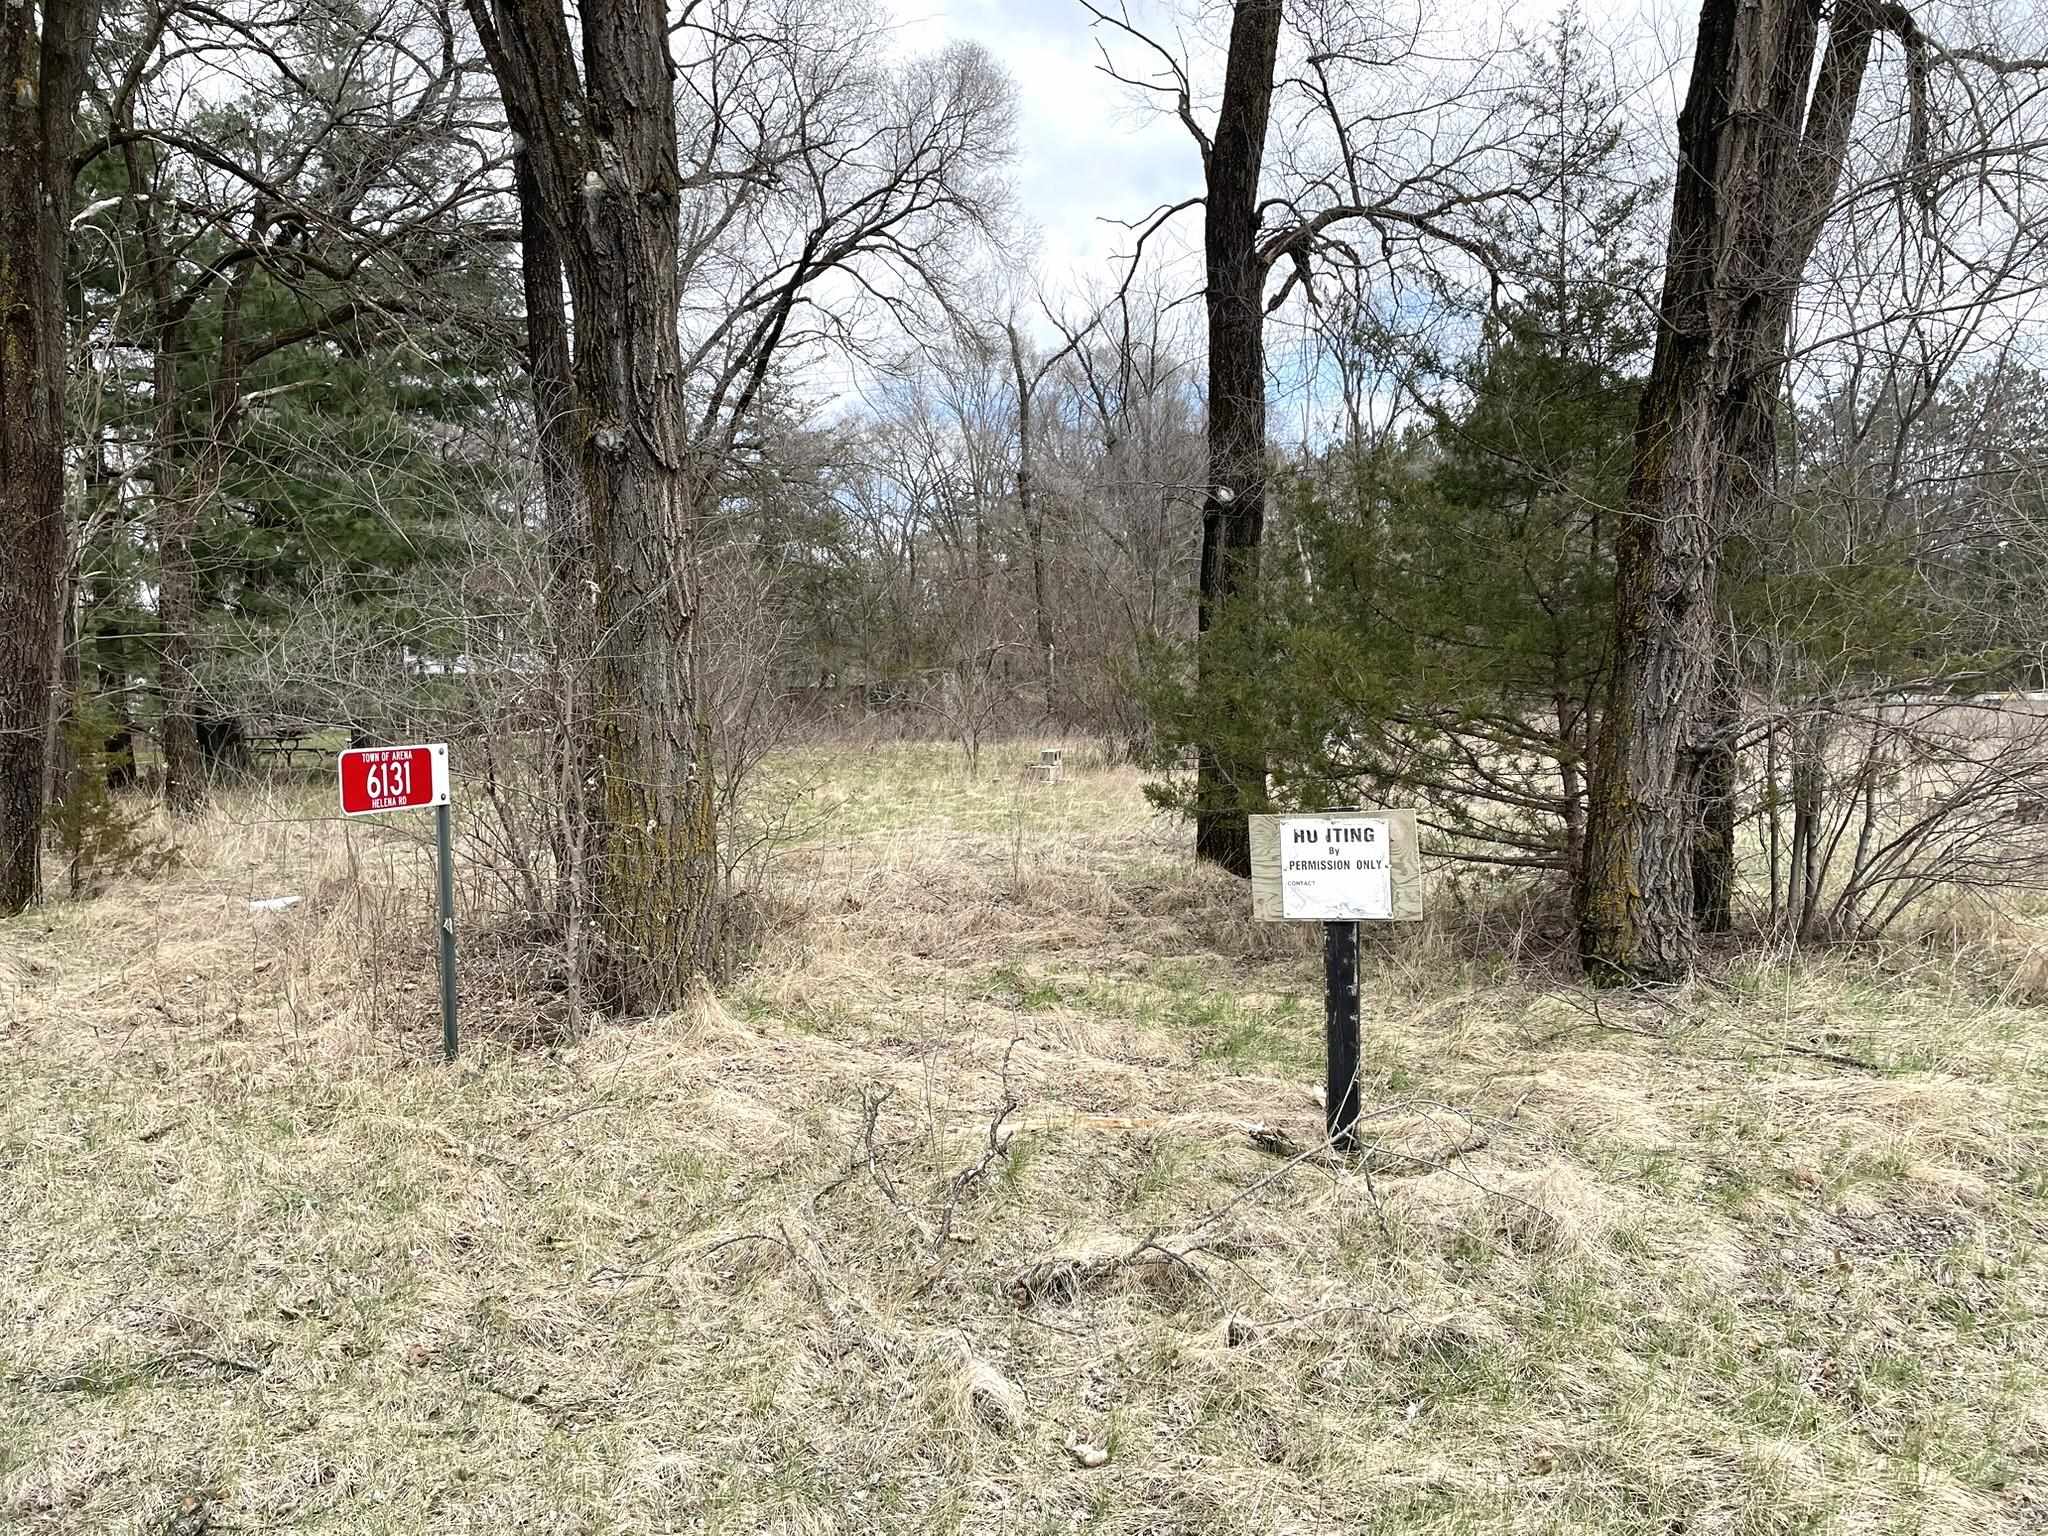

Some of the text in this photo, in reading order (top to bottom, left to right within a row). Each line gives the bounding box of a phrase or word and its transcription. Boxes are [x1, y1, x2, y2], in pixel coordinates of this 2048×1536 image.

[362, 750, 413, 763] TOWN OF ARENA
[366, 761, 411, 798] 6131
[372, 796, 408, 808] HELENA RD
[1328, 846, 1340, 856] By
[1289, 859, 1382, 870] PERMISSION ONLY
